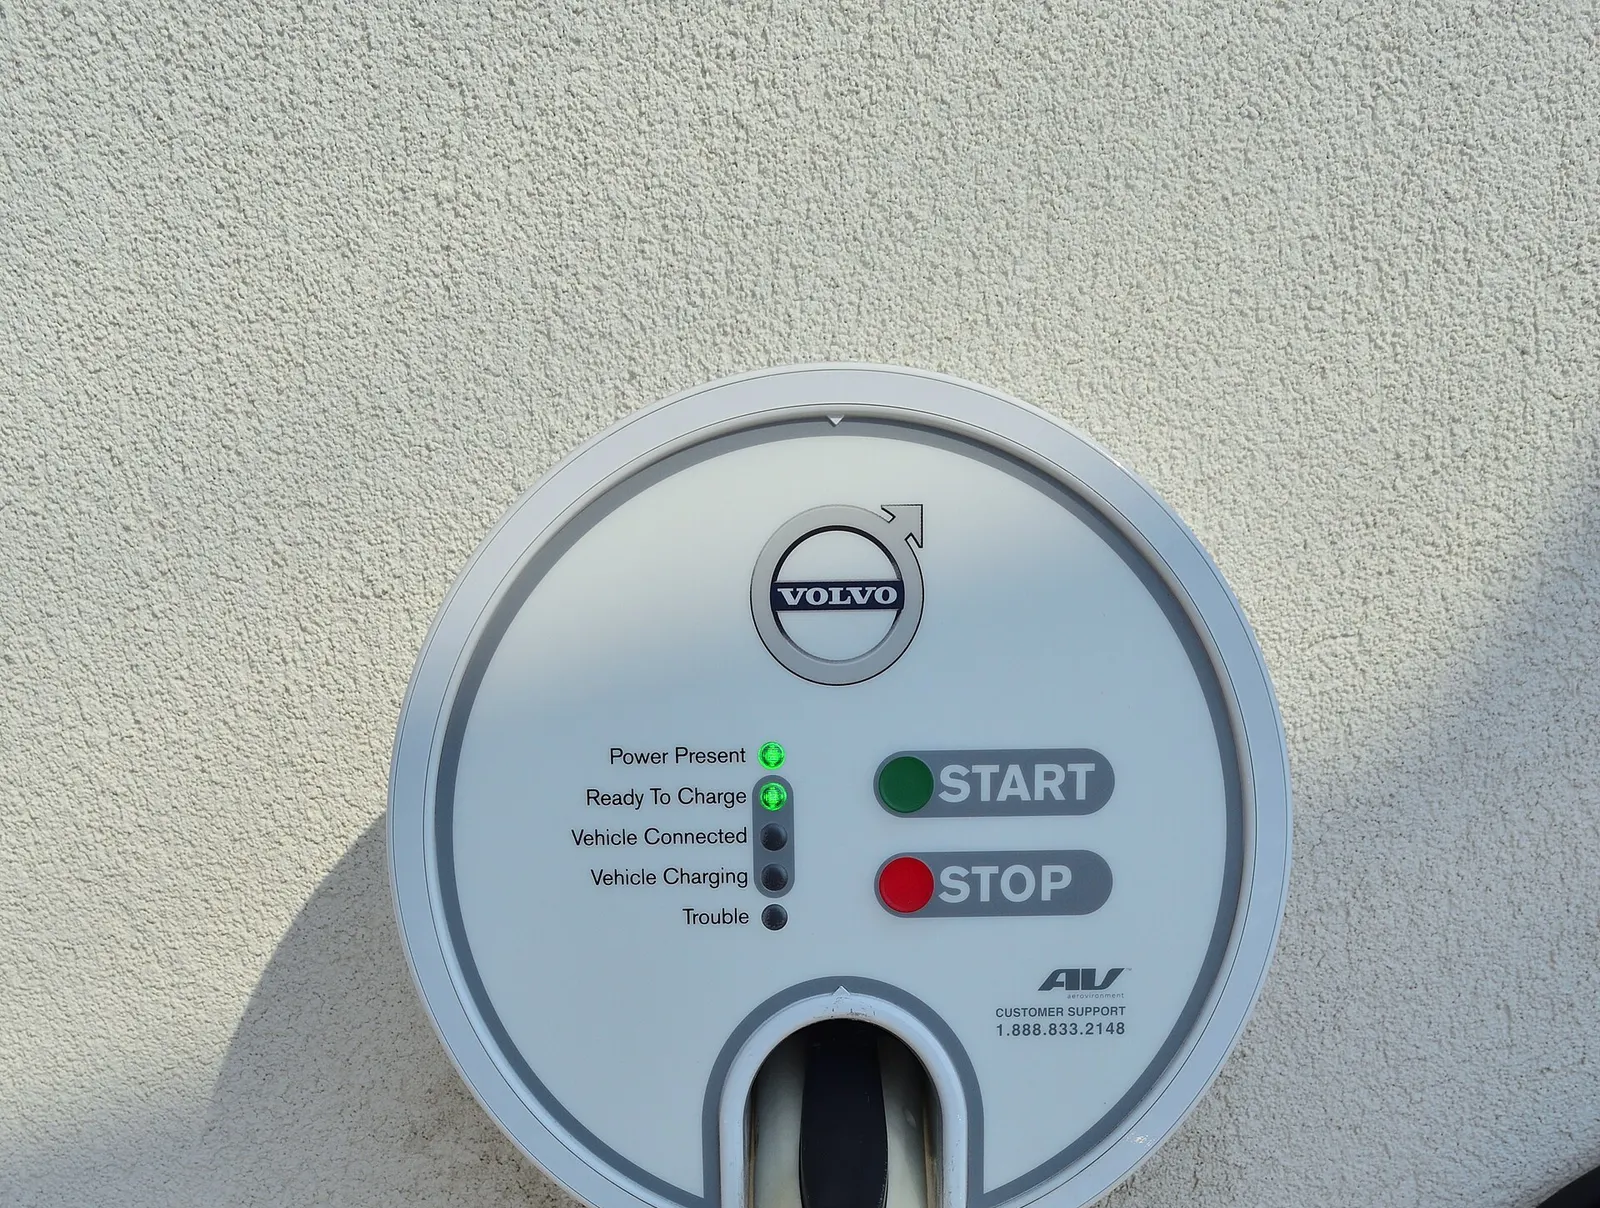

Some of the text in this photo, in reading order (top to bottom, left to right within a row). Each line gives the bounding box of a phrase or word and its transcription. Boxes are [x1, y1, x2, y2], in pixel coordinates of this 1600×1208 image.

[776, 586, 898, 606] VOLVO
[610, 746, 747, 765] Power Present
[938, 763, 1096, 803] START
[586, 787, 747, 811] Ready To Charge
[570, 826, 748, 846] Vehicle Connected
[590, 866, 748, 889] Vehicle Charging
[938, 864, 1072, 903] STOP
[682, 907, 750, 925] Trouble
[995, 1006, 1126, 1018] CUSTOMER SUPPORT
[996, 1021, 1125, 1037] 1.888.833.2148
